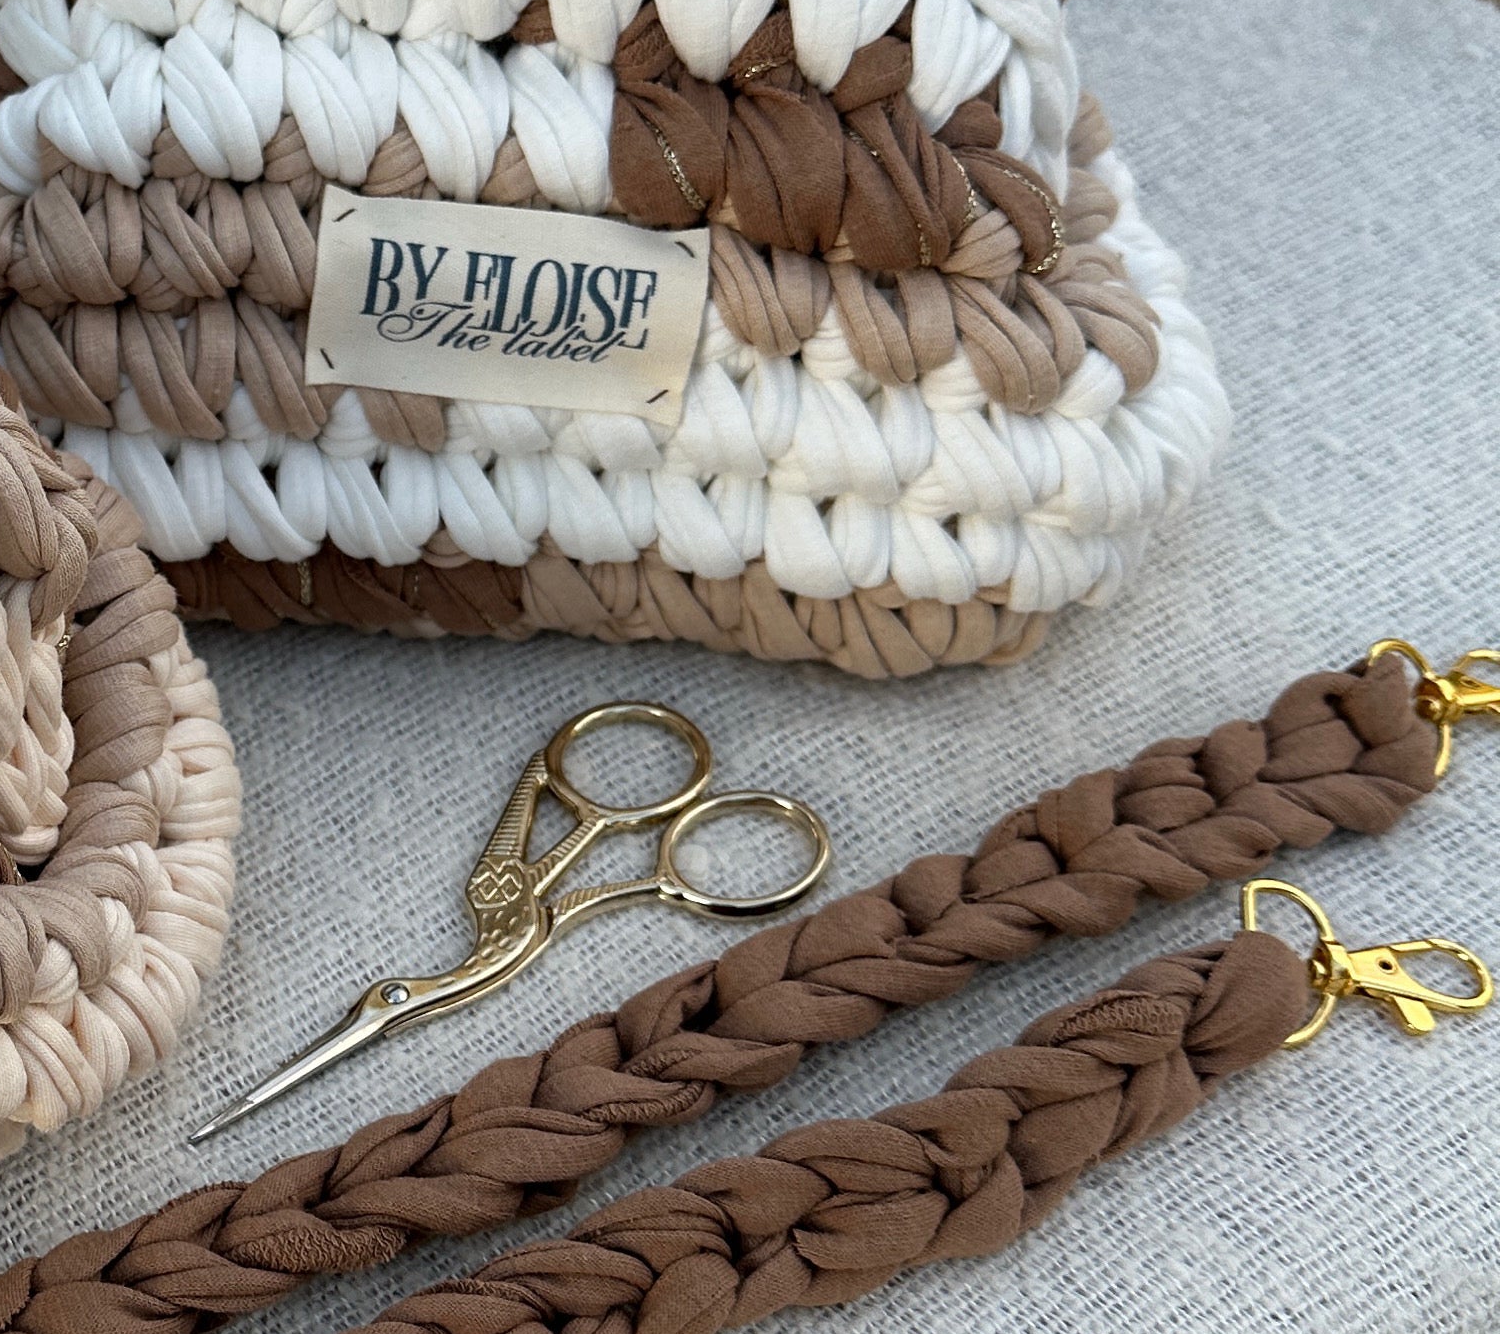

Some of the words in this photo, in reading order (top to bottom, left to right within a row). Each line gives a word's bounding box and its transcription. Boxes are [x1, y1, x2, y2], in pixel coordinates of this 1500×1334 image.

[360, 237, 449, 317] BY
[463, 251, 658, 350] ELOISE
[376, 301, 491, 351] The
[501, 320, 626, 364] label
